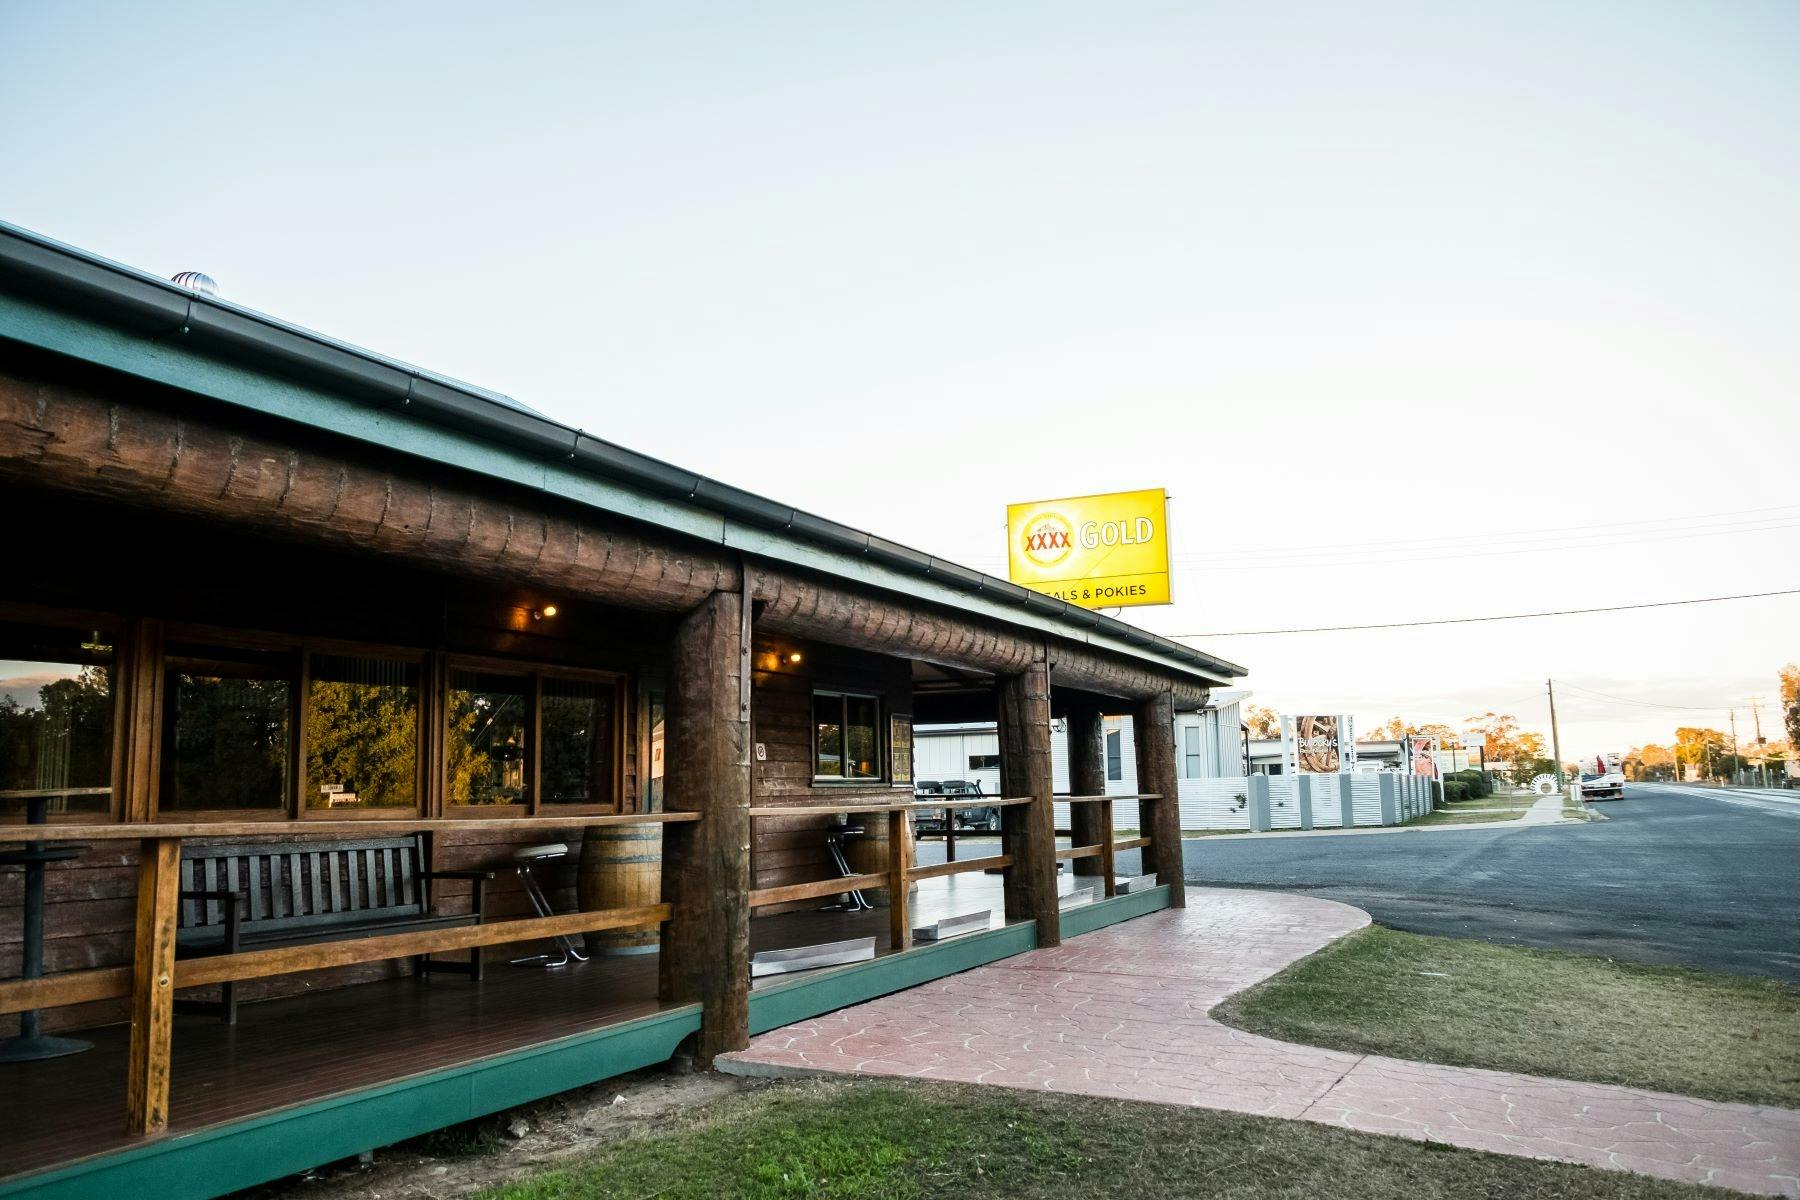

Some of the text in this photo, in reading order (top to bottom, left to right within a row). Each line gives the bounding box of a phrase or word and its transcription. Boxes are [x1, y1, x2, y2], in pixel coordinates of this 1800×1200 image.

[1025, 517, 1153, 551] XXXX GOLD
[1083, 589, 1090, 599] &
[1095, 584, 1146, 598] POKIES
